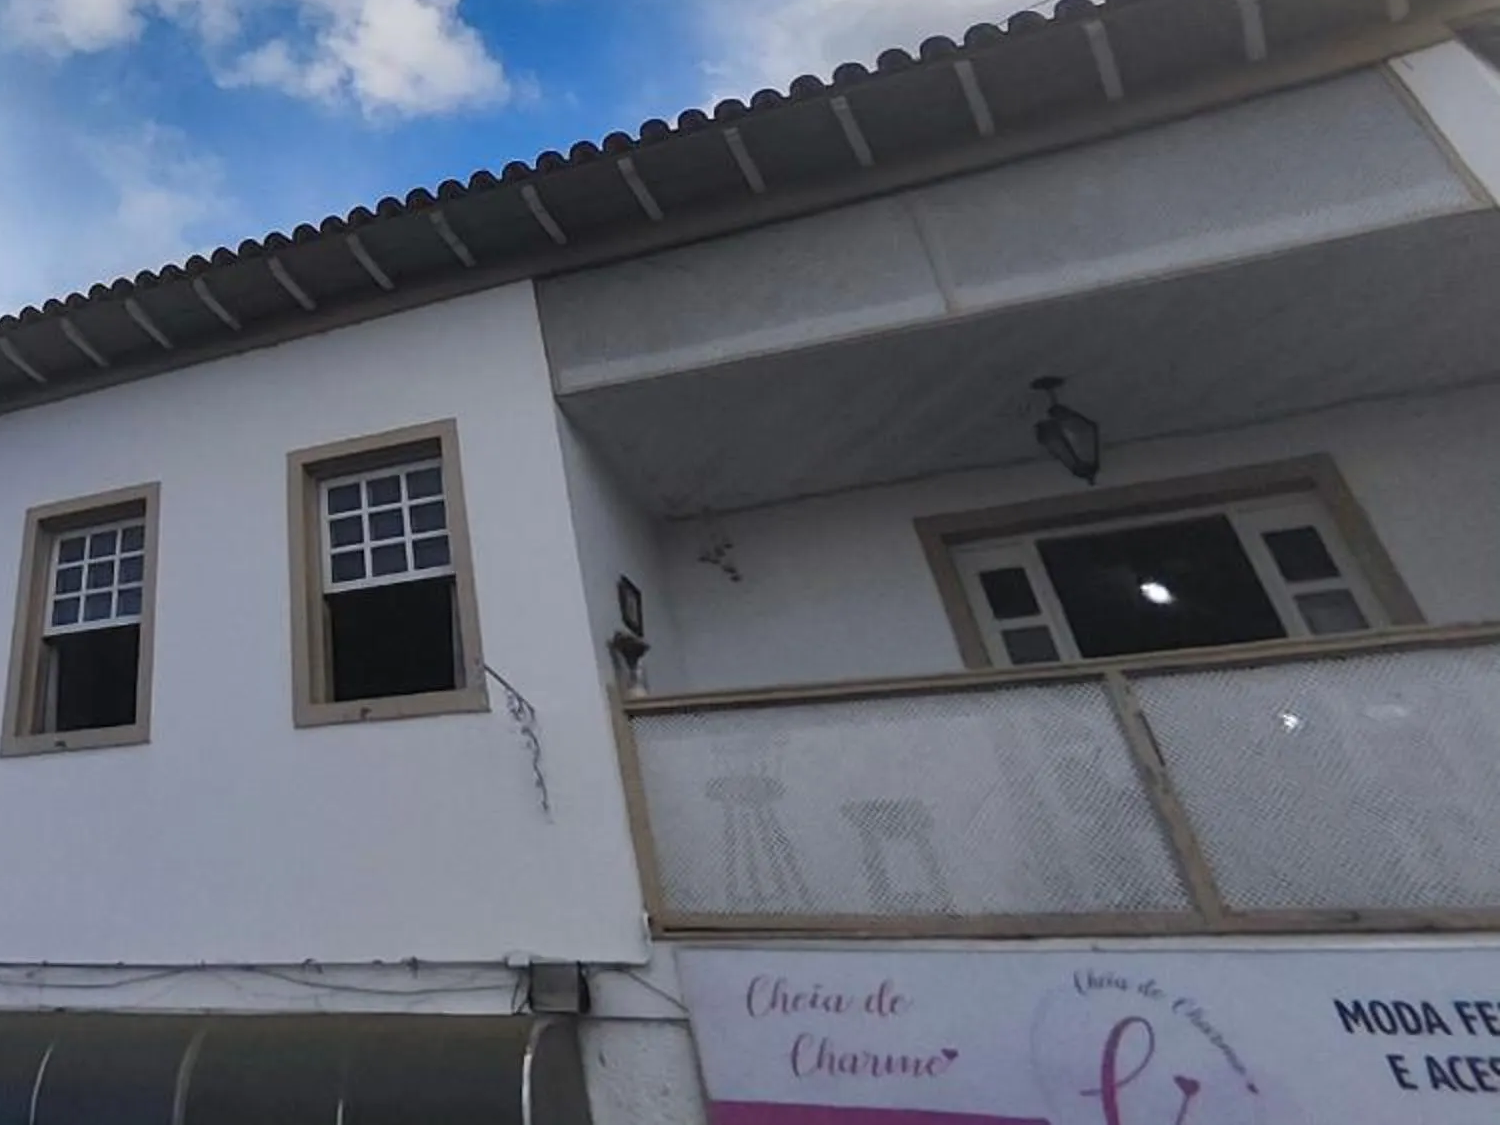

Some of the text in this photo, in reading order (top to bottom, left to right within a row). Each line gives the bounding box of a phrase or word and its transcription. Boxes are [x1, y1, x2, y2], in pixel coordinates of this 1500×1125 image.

[747, 974, 910, 1018] Cheia de
[1137, 978, 1166, 999] de
[1333, 999, 1500, 1036] MODA FE
[791, 1032, 945, 1077] Charme
[1385, 1054, 1419, 1090] E
